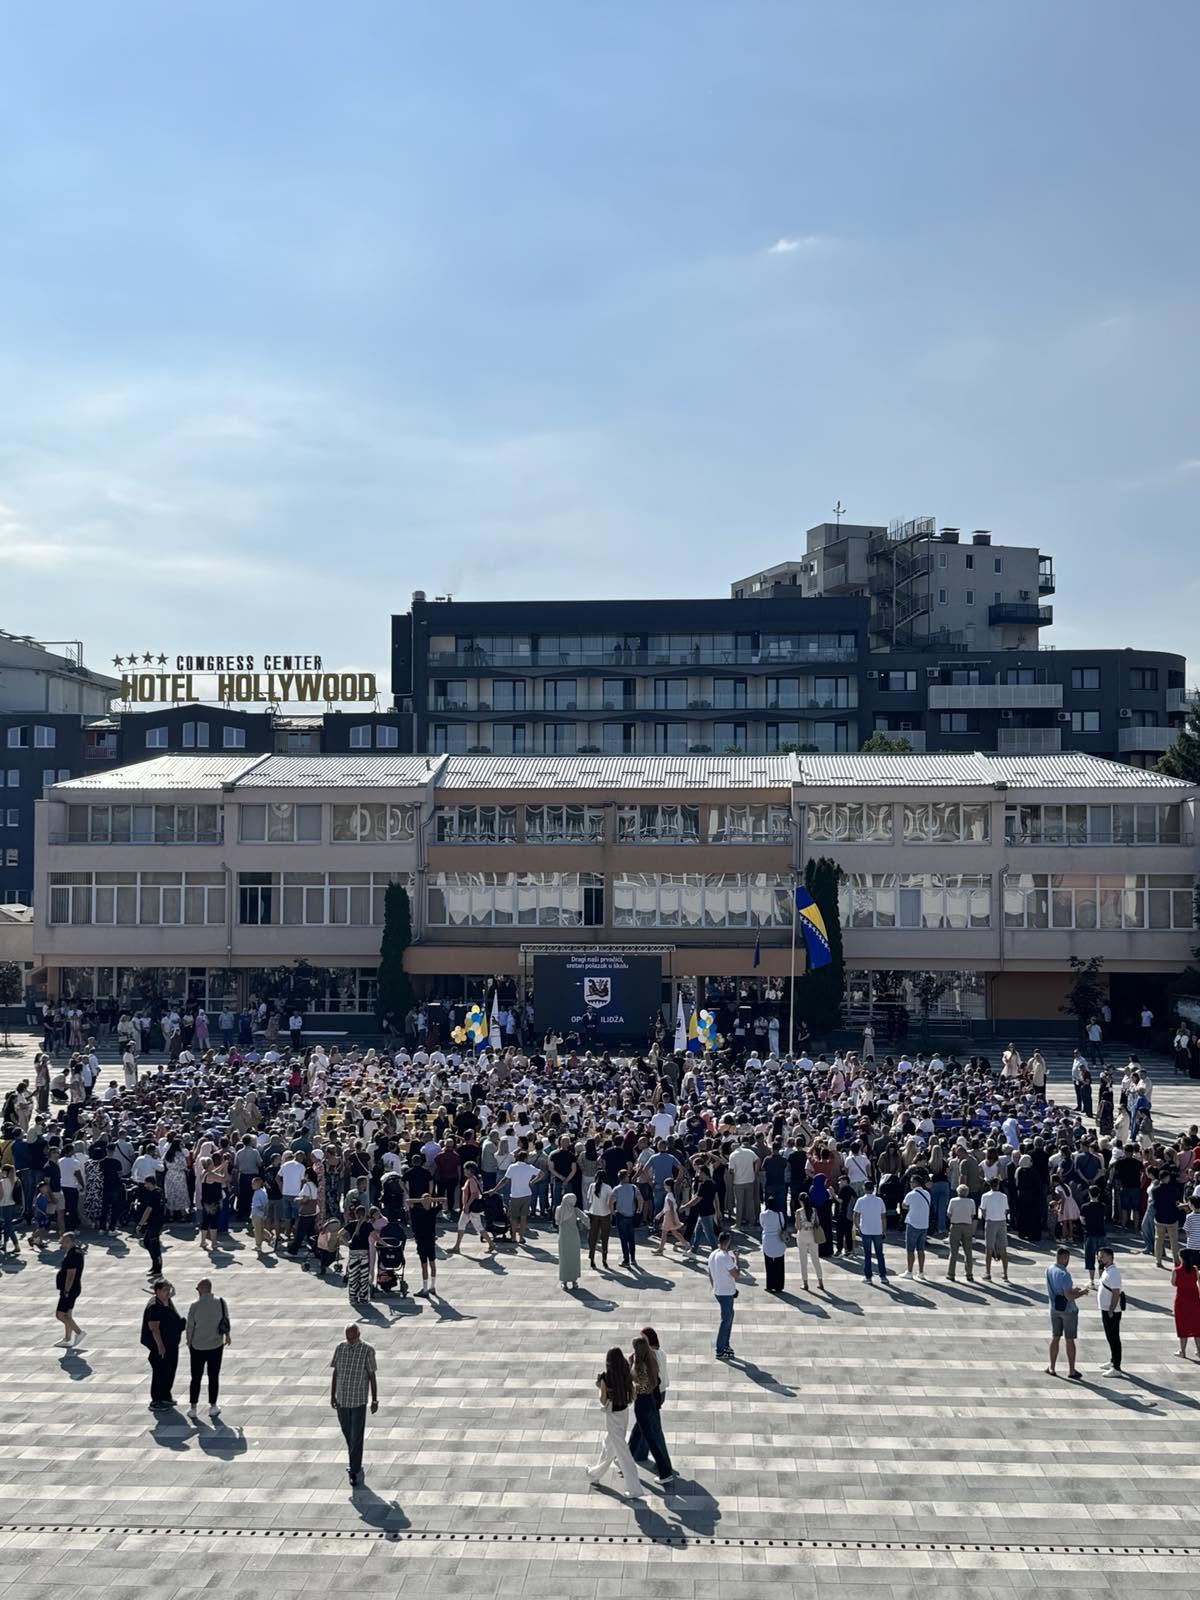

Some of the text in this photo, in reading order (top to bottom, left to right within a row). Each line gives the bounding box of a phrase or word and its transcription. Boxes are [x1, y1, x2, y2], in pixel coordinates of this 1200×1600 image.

[176, 655, 322, 671] CONGRESS CENTER
[121, 673, 376, 702] HOTEL HOLLYWOOD
[600, 1015, 624, 1023] ILIDŽA
